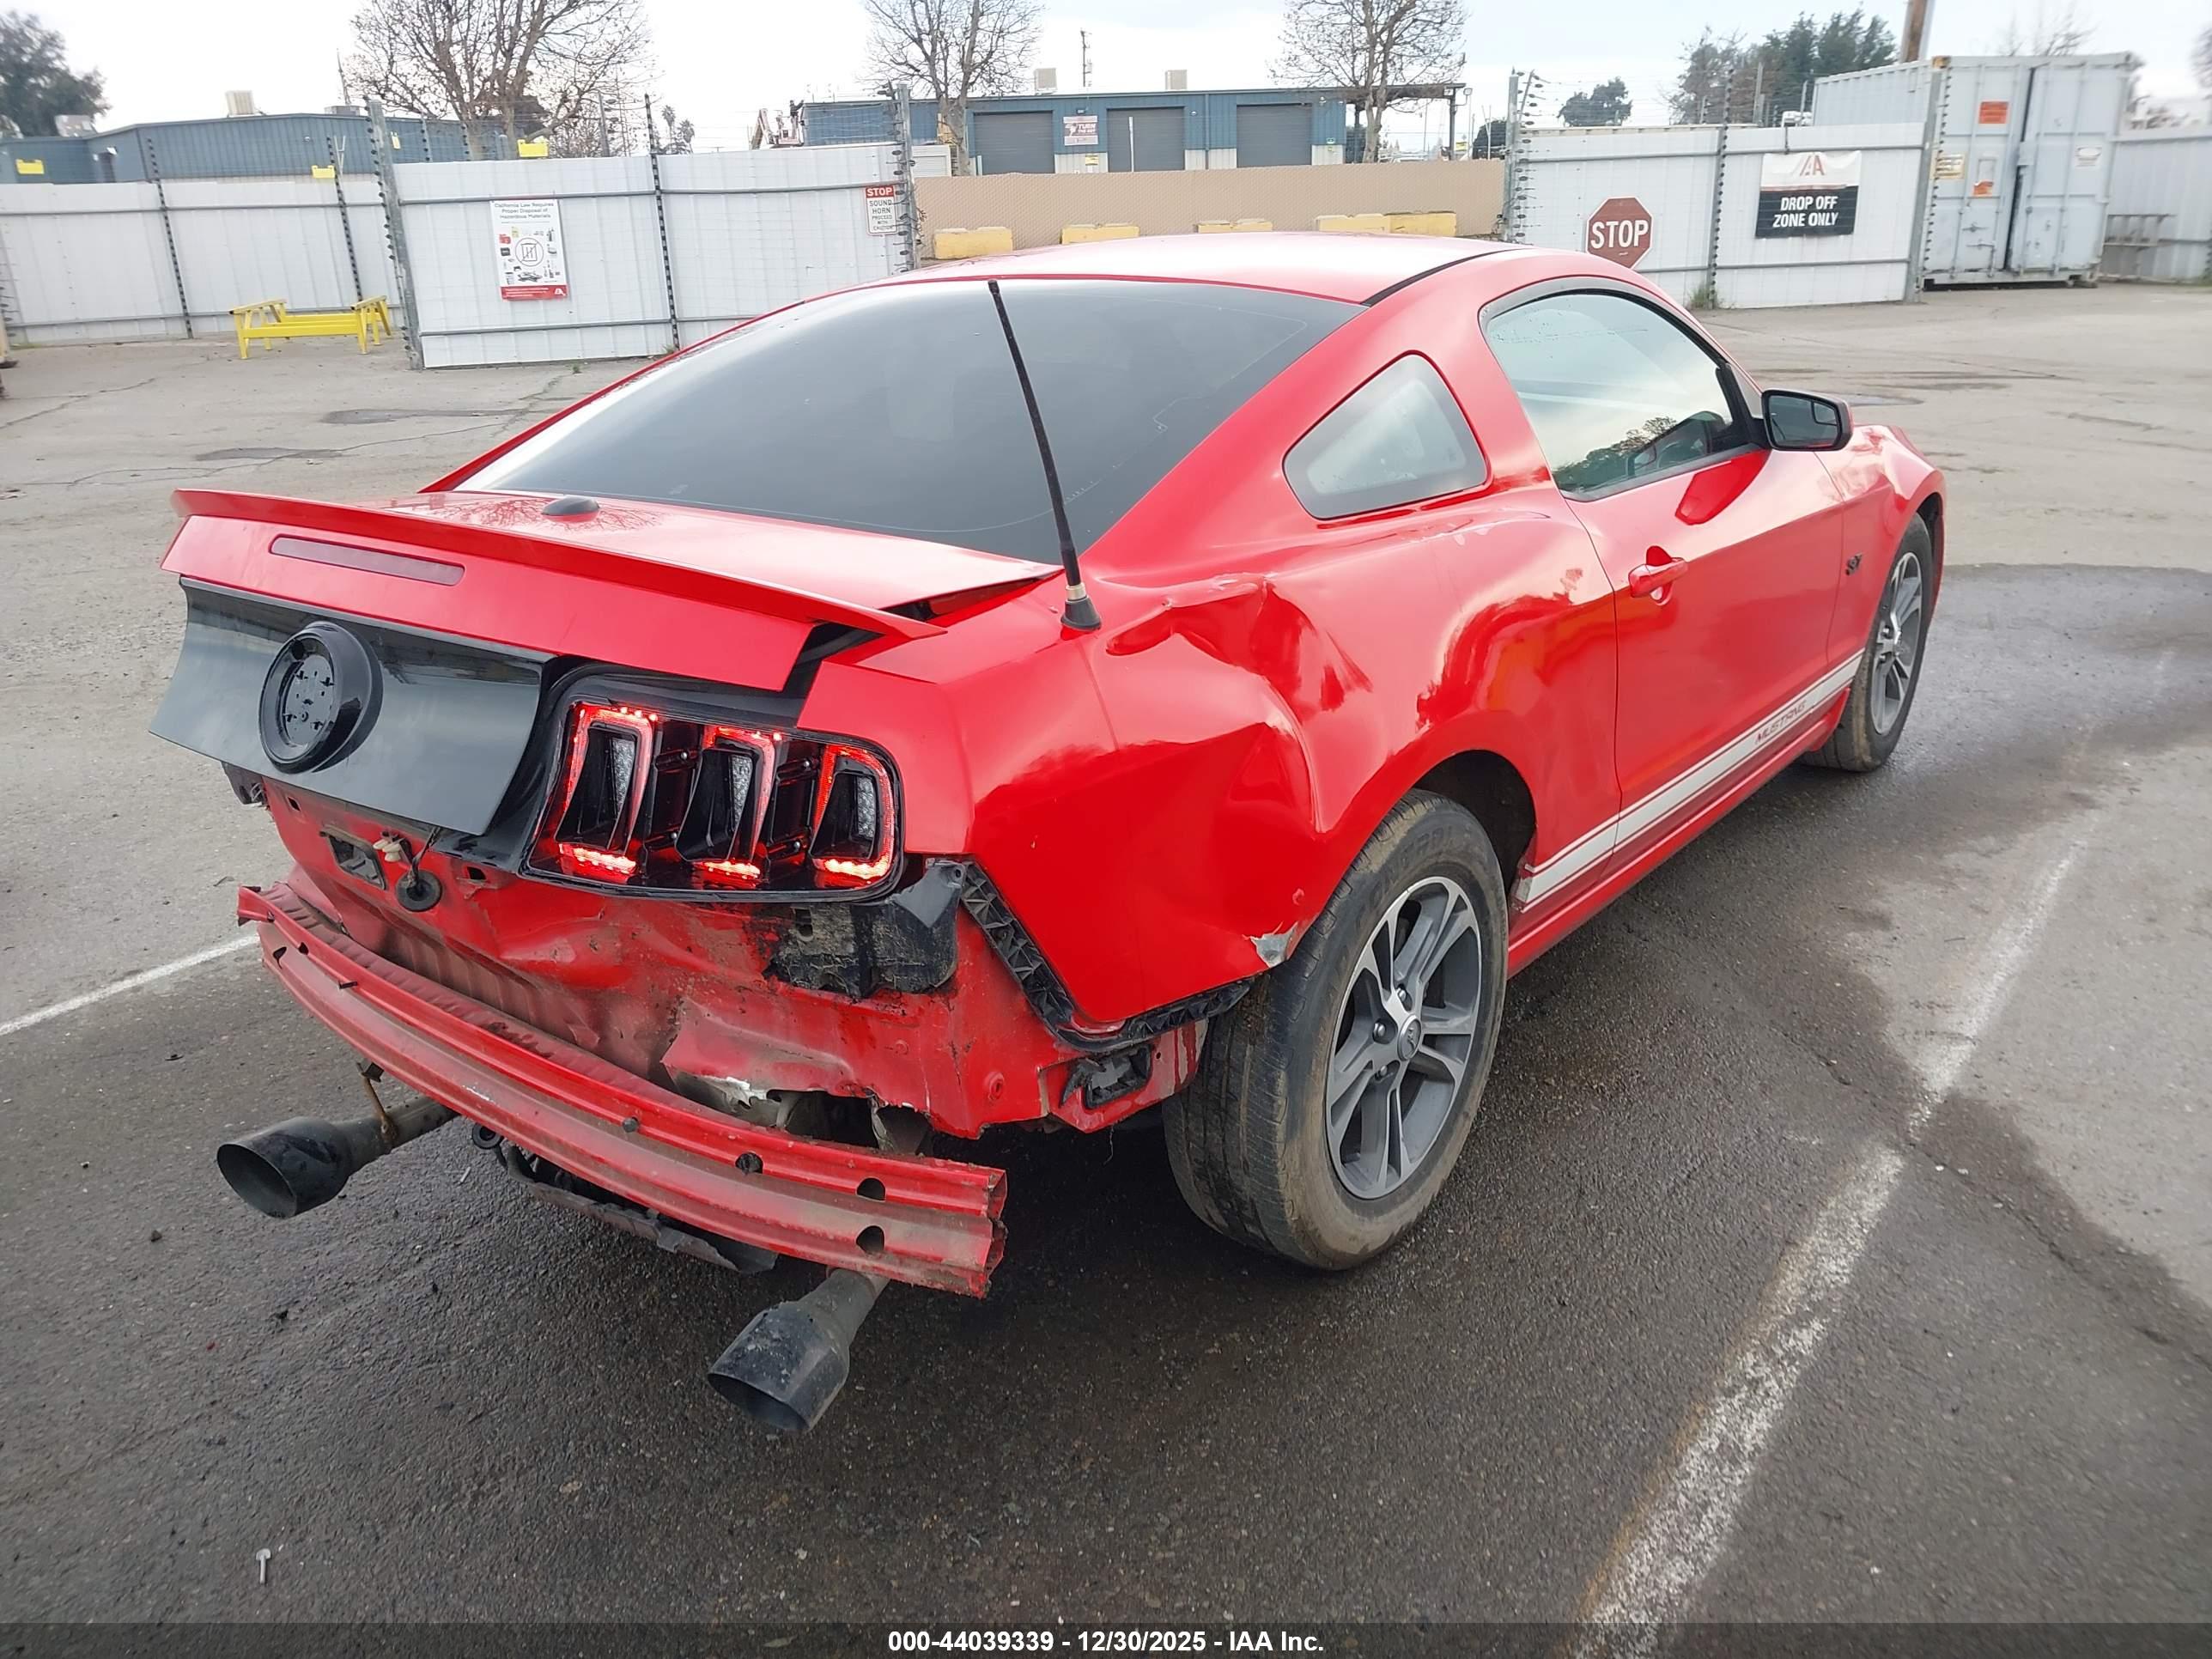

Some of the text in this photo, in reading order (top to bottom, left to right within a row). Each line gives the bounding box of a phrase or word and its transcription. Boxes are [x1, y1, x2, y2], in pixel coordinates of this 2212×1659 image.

[866, 186, 893, 197] STOP
[1780, 196, 1838, 211] DROP OFF
[1772, 212, 1838, 228] ZONE ONLY
[1590, 219, 1649, 249] STOP
